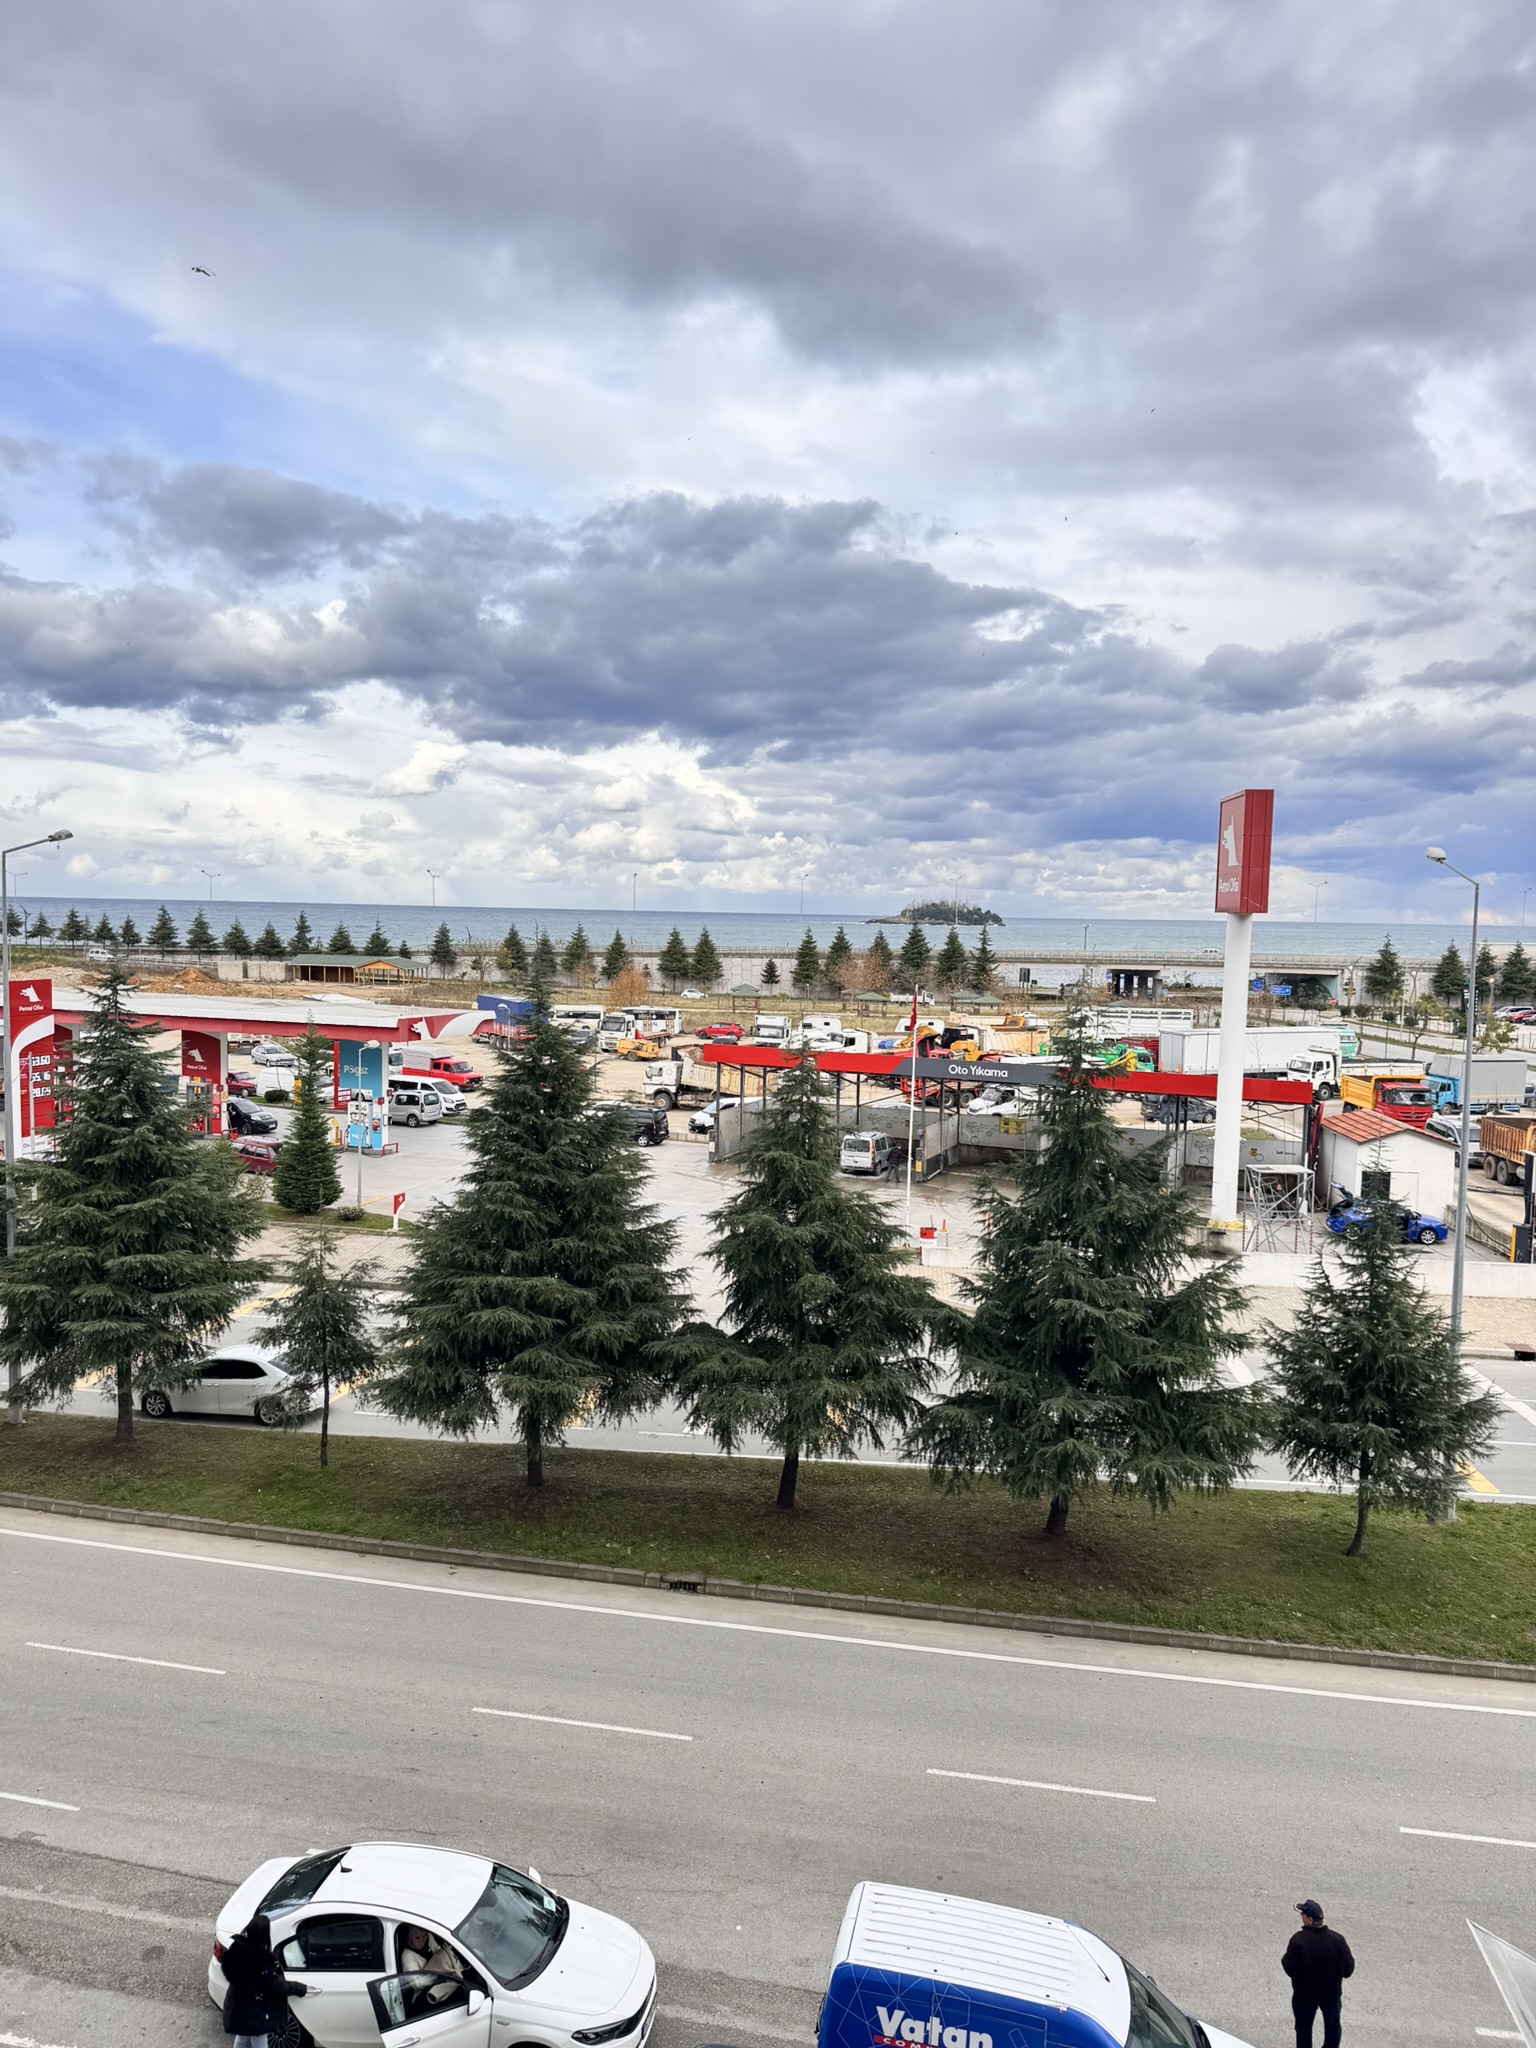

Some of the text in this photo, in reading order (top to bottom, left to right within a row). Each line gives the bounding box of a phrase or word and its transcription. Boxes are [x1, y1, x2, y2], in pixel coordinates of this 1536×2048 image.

[948, 1064, 1008, 1078] Oto Yıkama
[876, 2005, 993, 2048] Vatan
